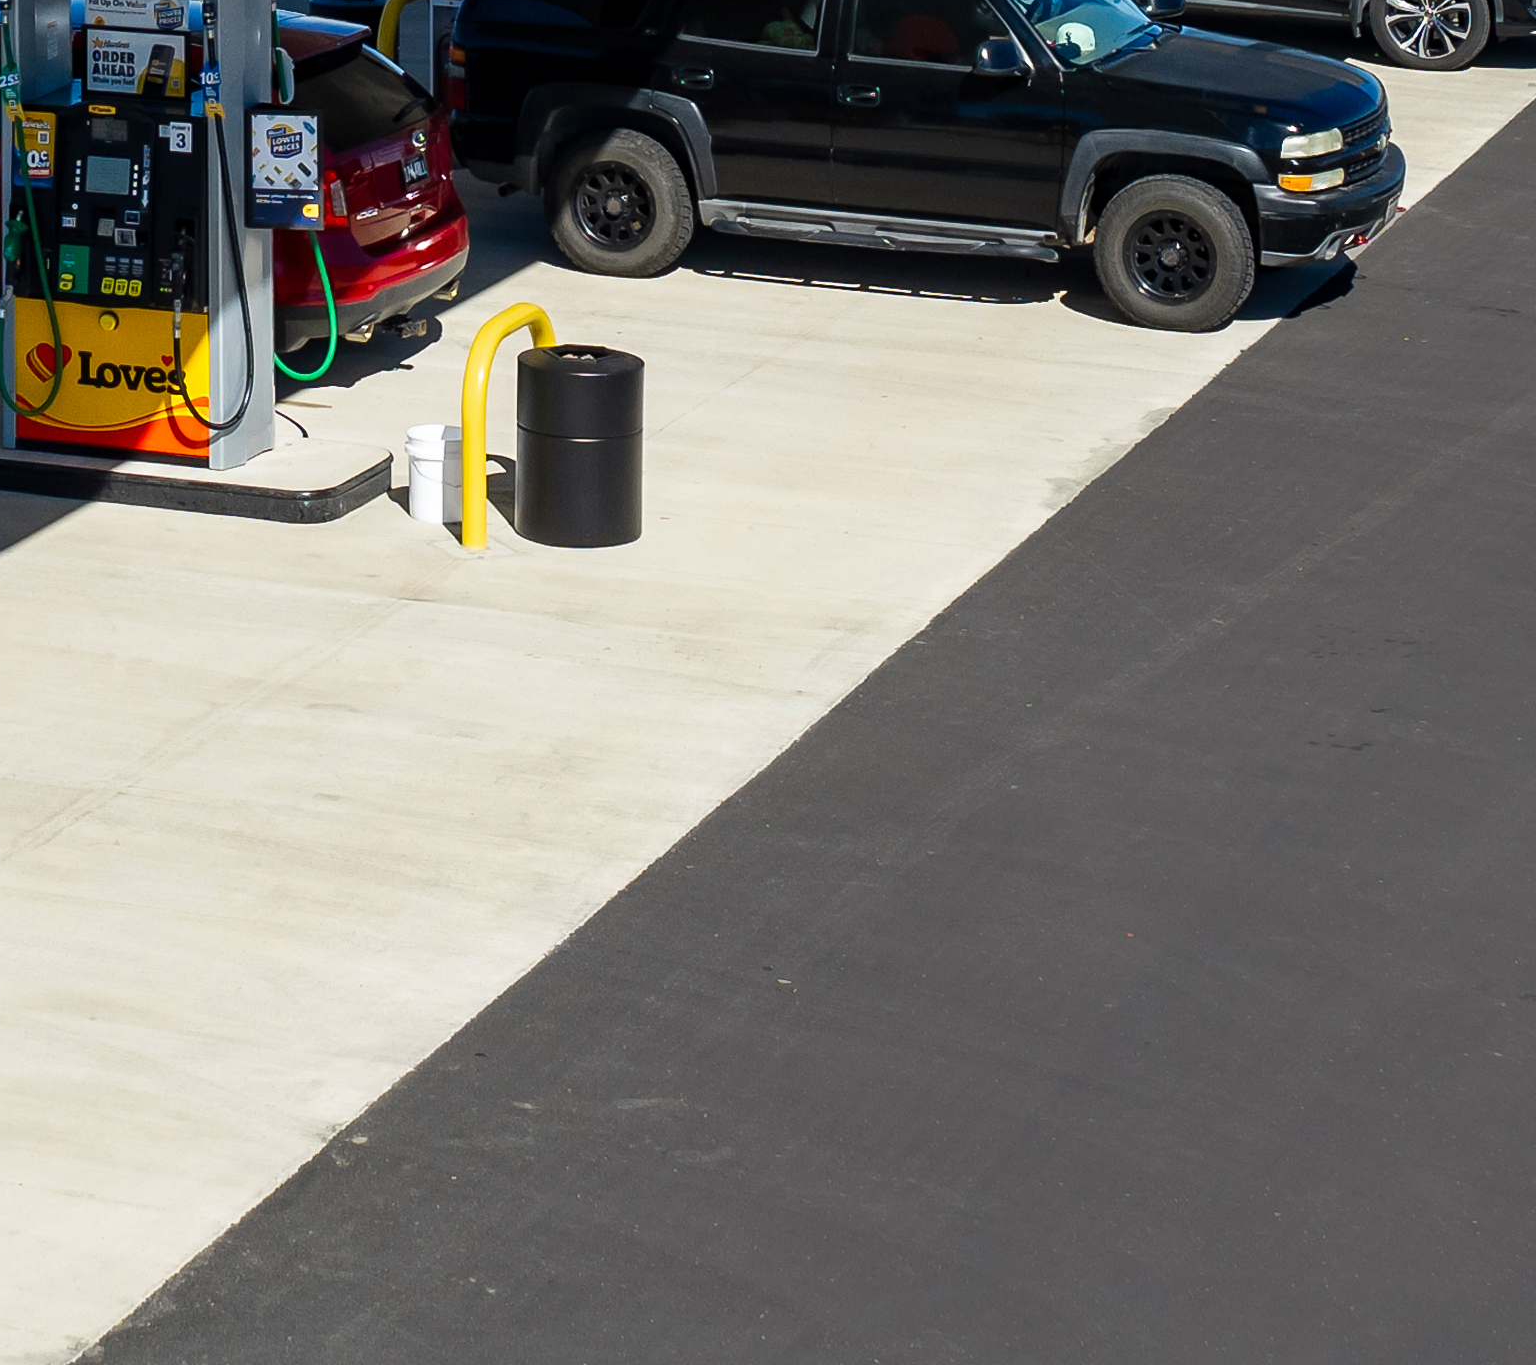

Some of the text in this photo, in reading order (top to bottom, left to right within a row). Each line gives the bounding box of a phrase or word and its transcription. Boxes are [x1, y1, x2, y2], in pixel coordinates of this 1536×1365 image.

[92, 49, 135, 65] ORDER
[92, 63, 136, 78] AHEAD
[176, 133, 186, 149] 3
